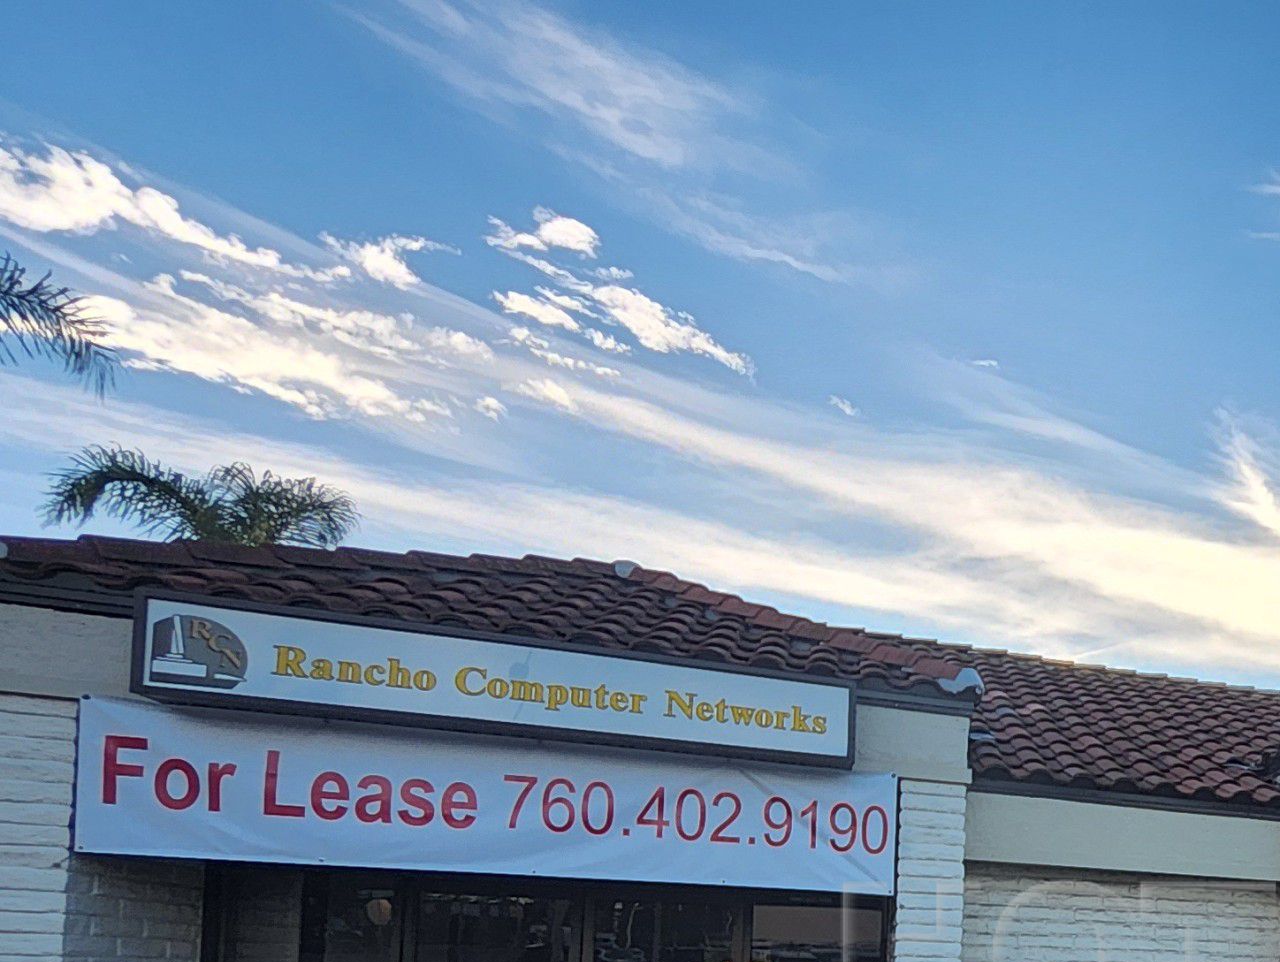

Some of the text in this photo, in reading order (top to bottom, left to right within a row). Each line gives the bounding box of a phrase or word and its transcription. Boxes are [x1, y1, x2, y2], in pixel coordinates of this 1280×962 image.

[273, 644, 828, 736] Rancho Computer Networks
[101, 734, 890, 856] For Lease 760.402.9190
